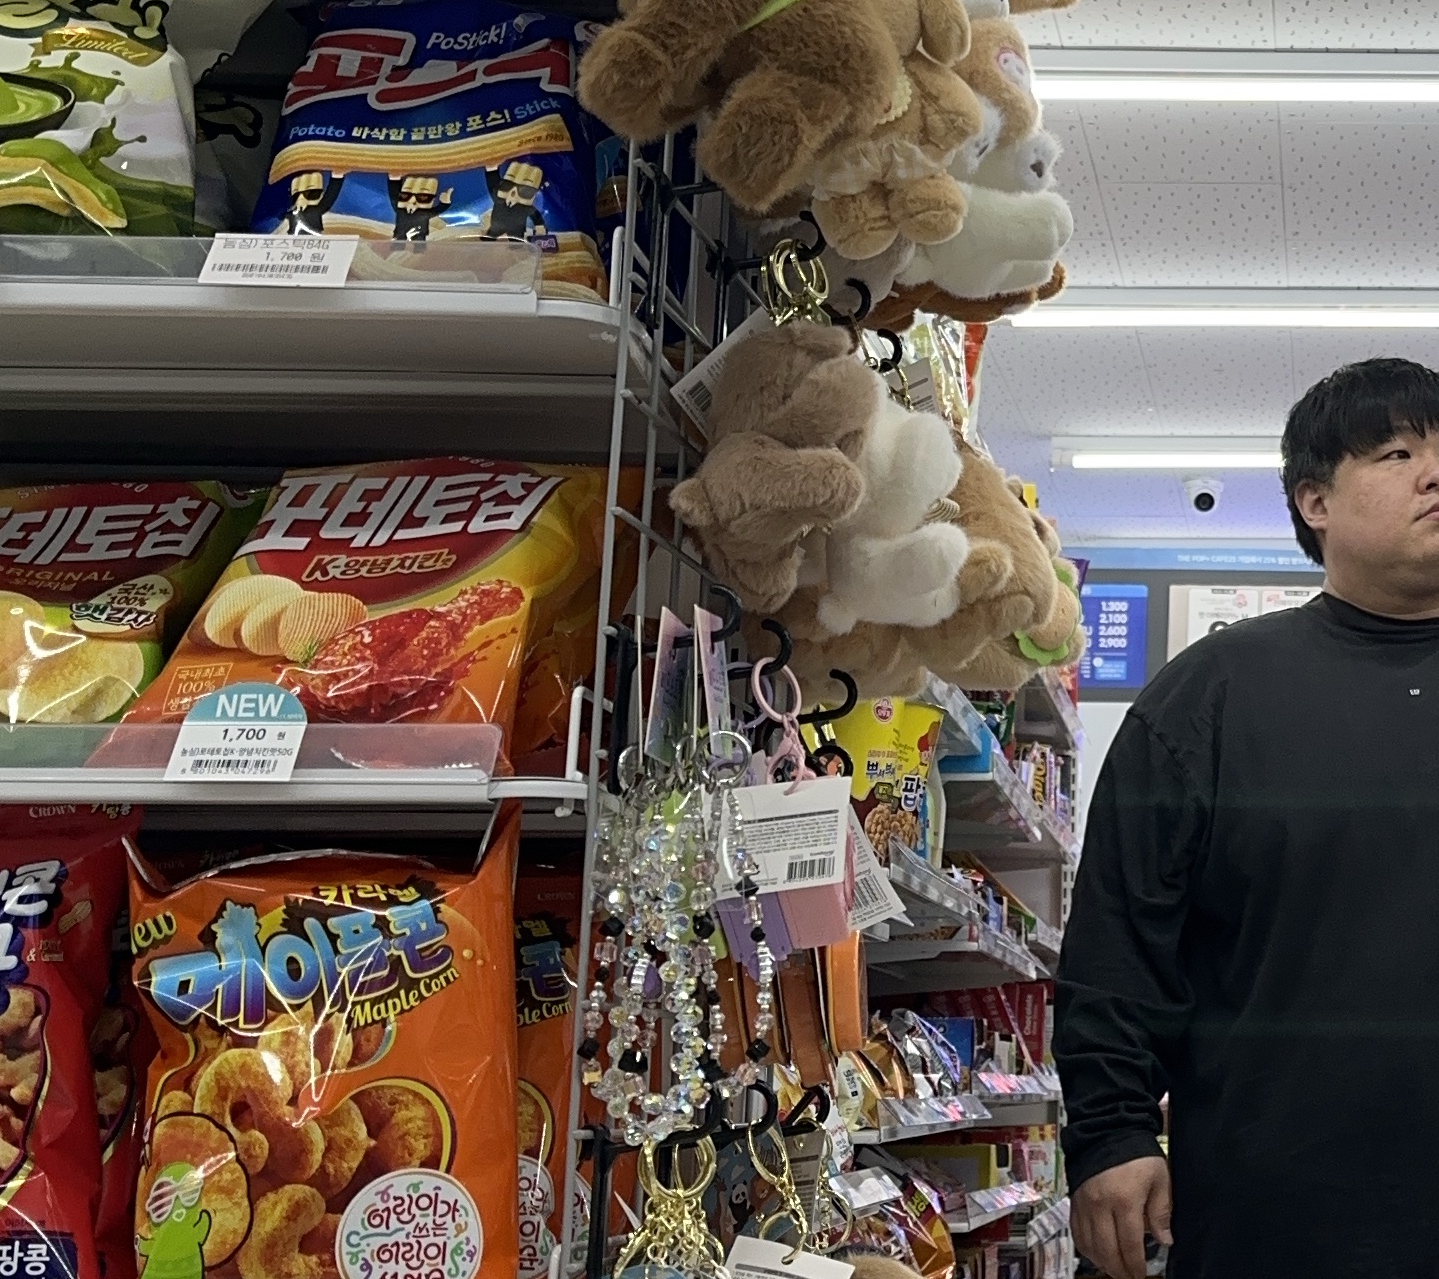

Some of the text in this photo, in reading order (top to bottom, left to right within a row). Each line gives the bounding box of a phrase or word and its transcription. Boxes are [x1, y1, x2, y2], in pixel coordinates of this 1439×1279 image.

[58, 26, 149, 63] Limited
[289, 123, 347, 141] Potato
[410, 121, 462, 141] 끝판왕
[513, 97, 562, 121] Stick
[264, 252, 303, 263] 1,700
[232, 471, 567, 558] 포테토칩
[0, 495, 223, 566] 테토칩
[0, 566, 115, 582] RIGINAL
[107, 594, 149, 609] 100%
[1098, 625, 1127, 637] 2,600
[1098, 637, 1127, 649] 2,900
[176, 680, 217, 696] 100%
[215, 693, 286, 719] NEW
[222, 728, 268, 743] 1,700
[29, 804, 77, 819] CROWN
[131, 911, 177, 955] ew
[150, 898, 456, 1030] 메이플콘
[350, 965, 460, 1030] Maple Corn
[376, 1239, 448, 1272] 어린이
